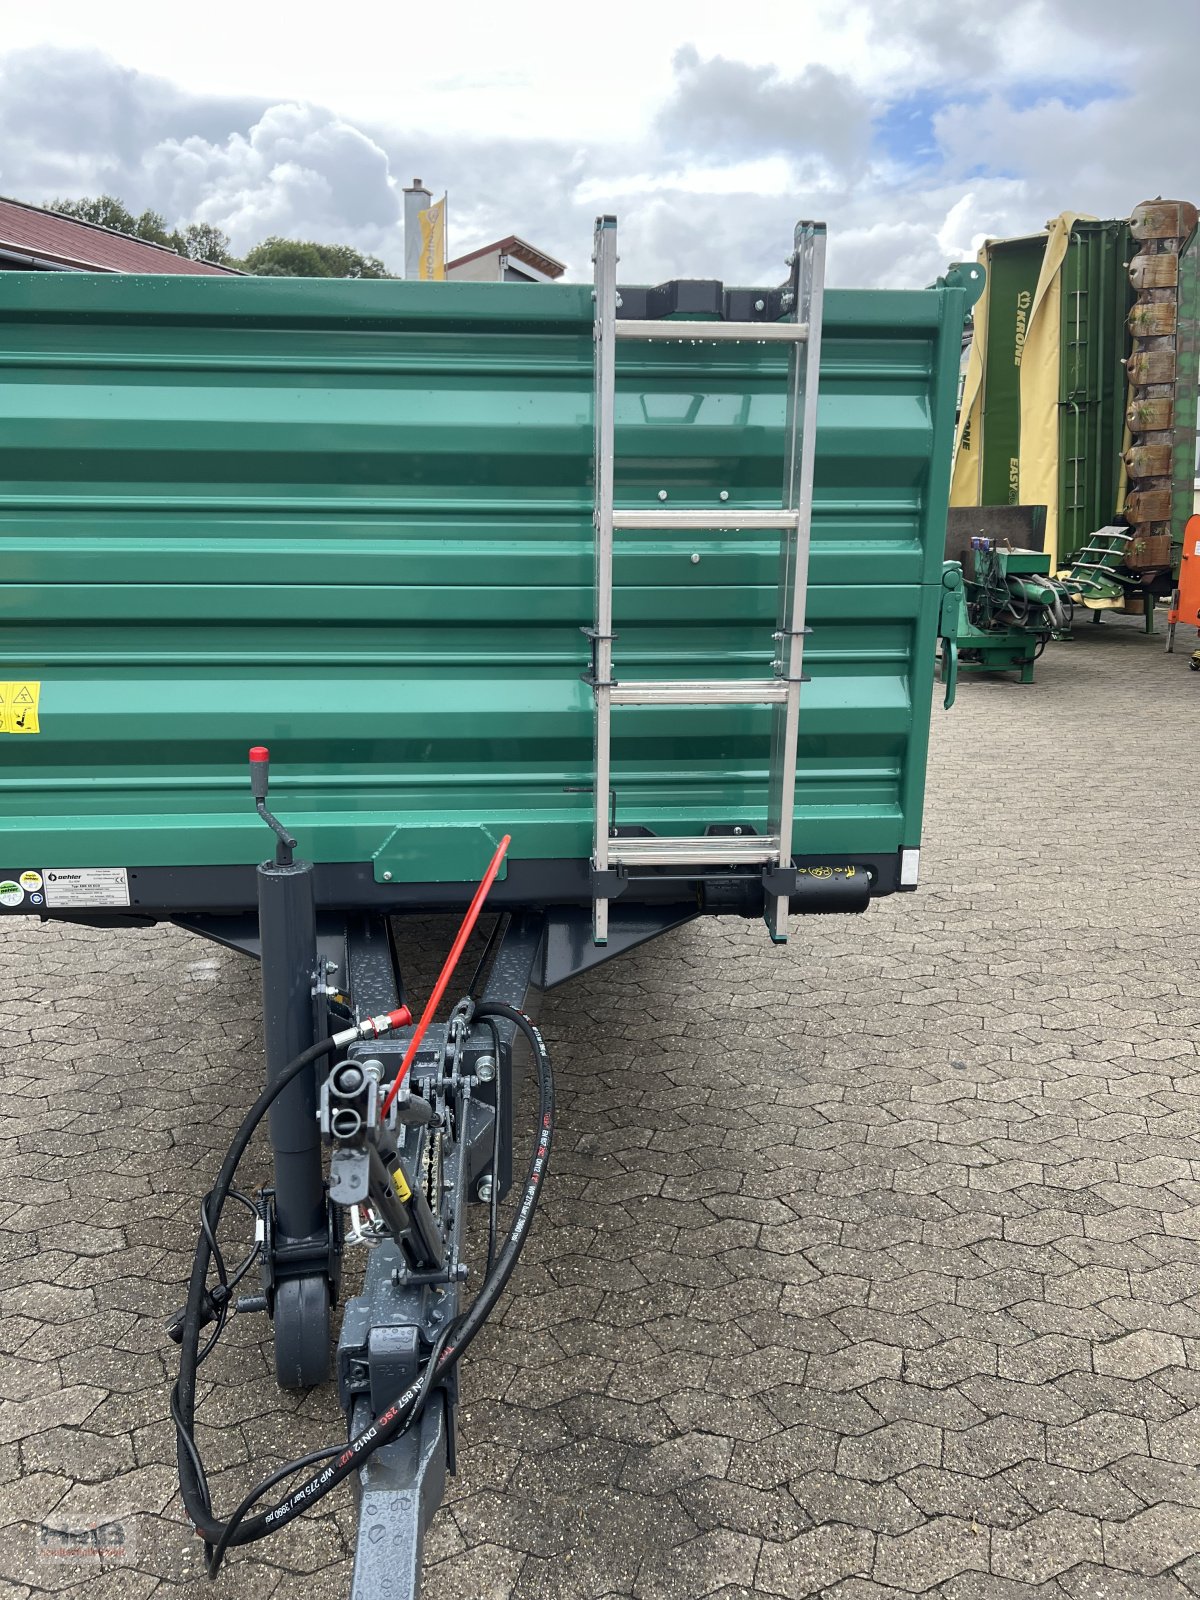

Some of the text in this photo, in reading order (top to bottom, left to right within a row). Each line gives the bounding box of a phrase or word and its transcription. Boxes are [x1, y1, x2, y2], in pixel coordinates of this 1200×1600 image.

[1014, 309, 1027, 367] KRONE
[961, 417, 972, 451] ONE
[398, 1391, 414, 1409] 857
[379, 1407, 398, 1426] 2SC
[353, 1427, 377, 1452] DN12
[320, 1467, 334, 1484] WP
[306, 1479, 320, 1494] 275
[293, 1491, 306, 1504] bar
[264, 1511, 275, 1524] psi
[274, 1503, 291, 1519] 3990
